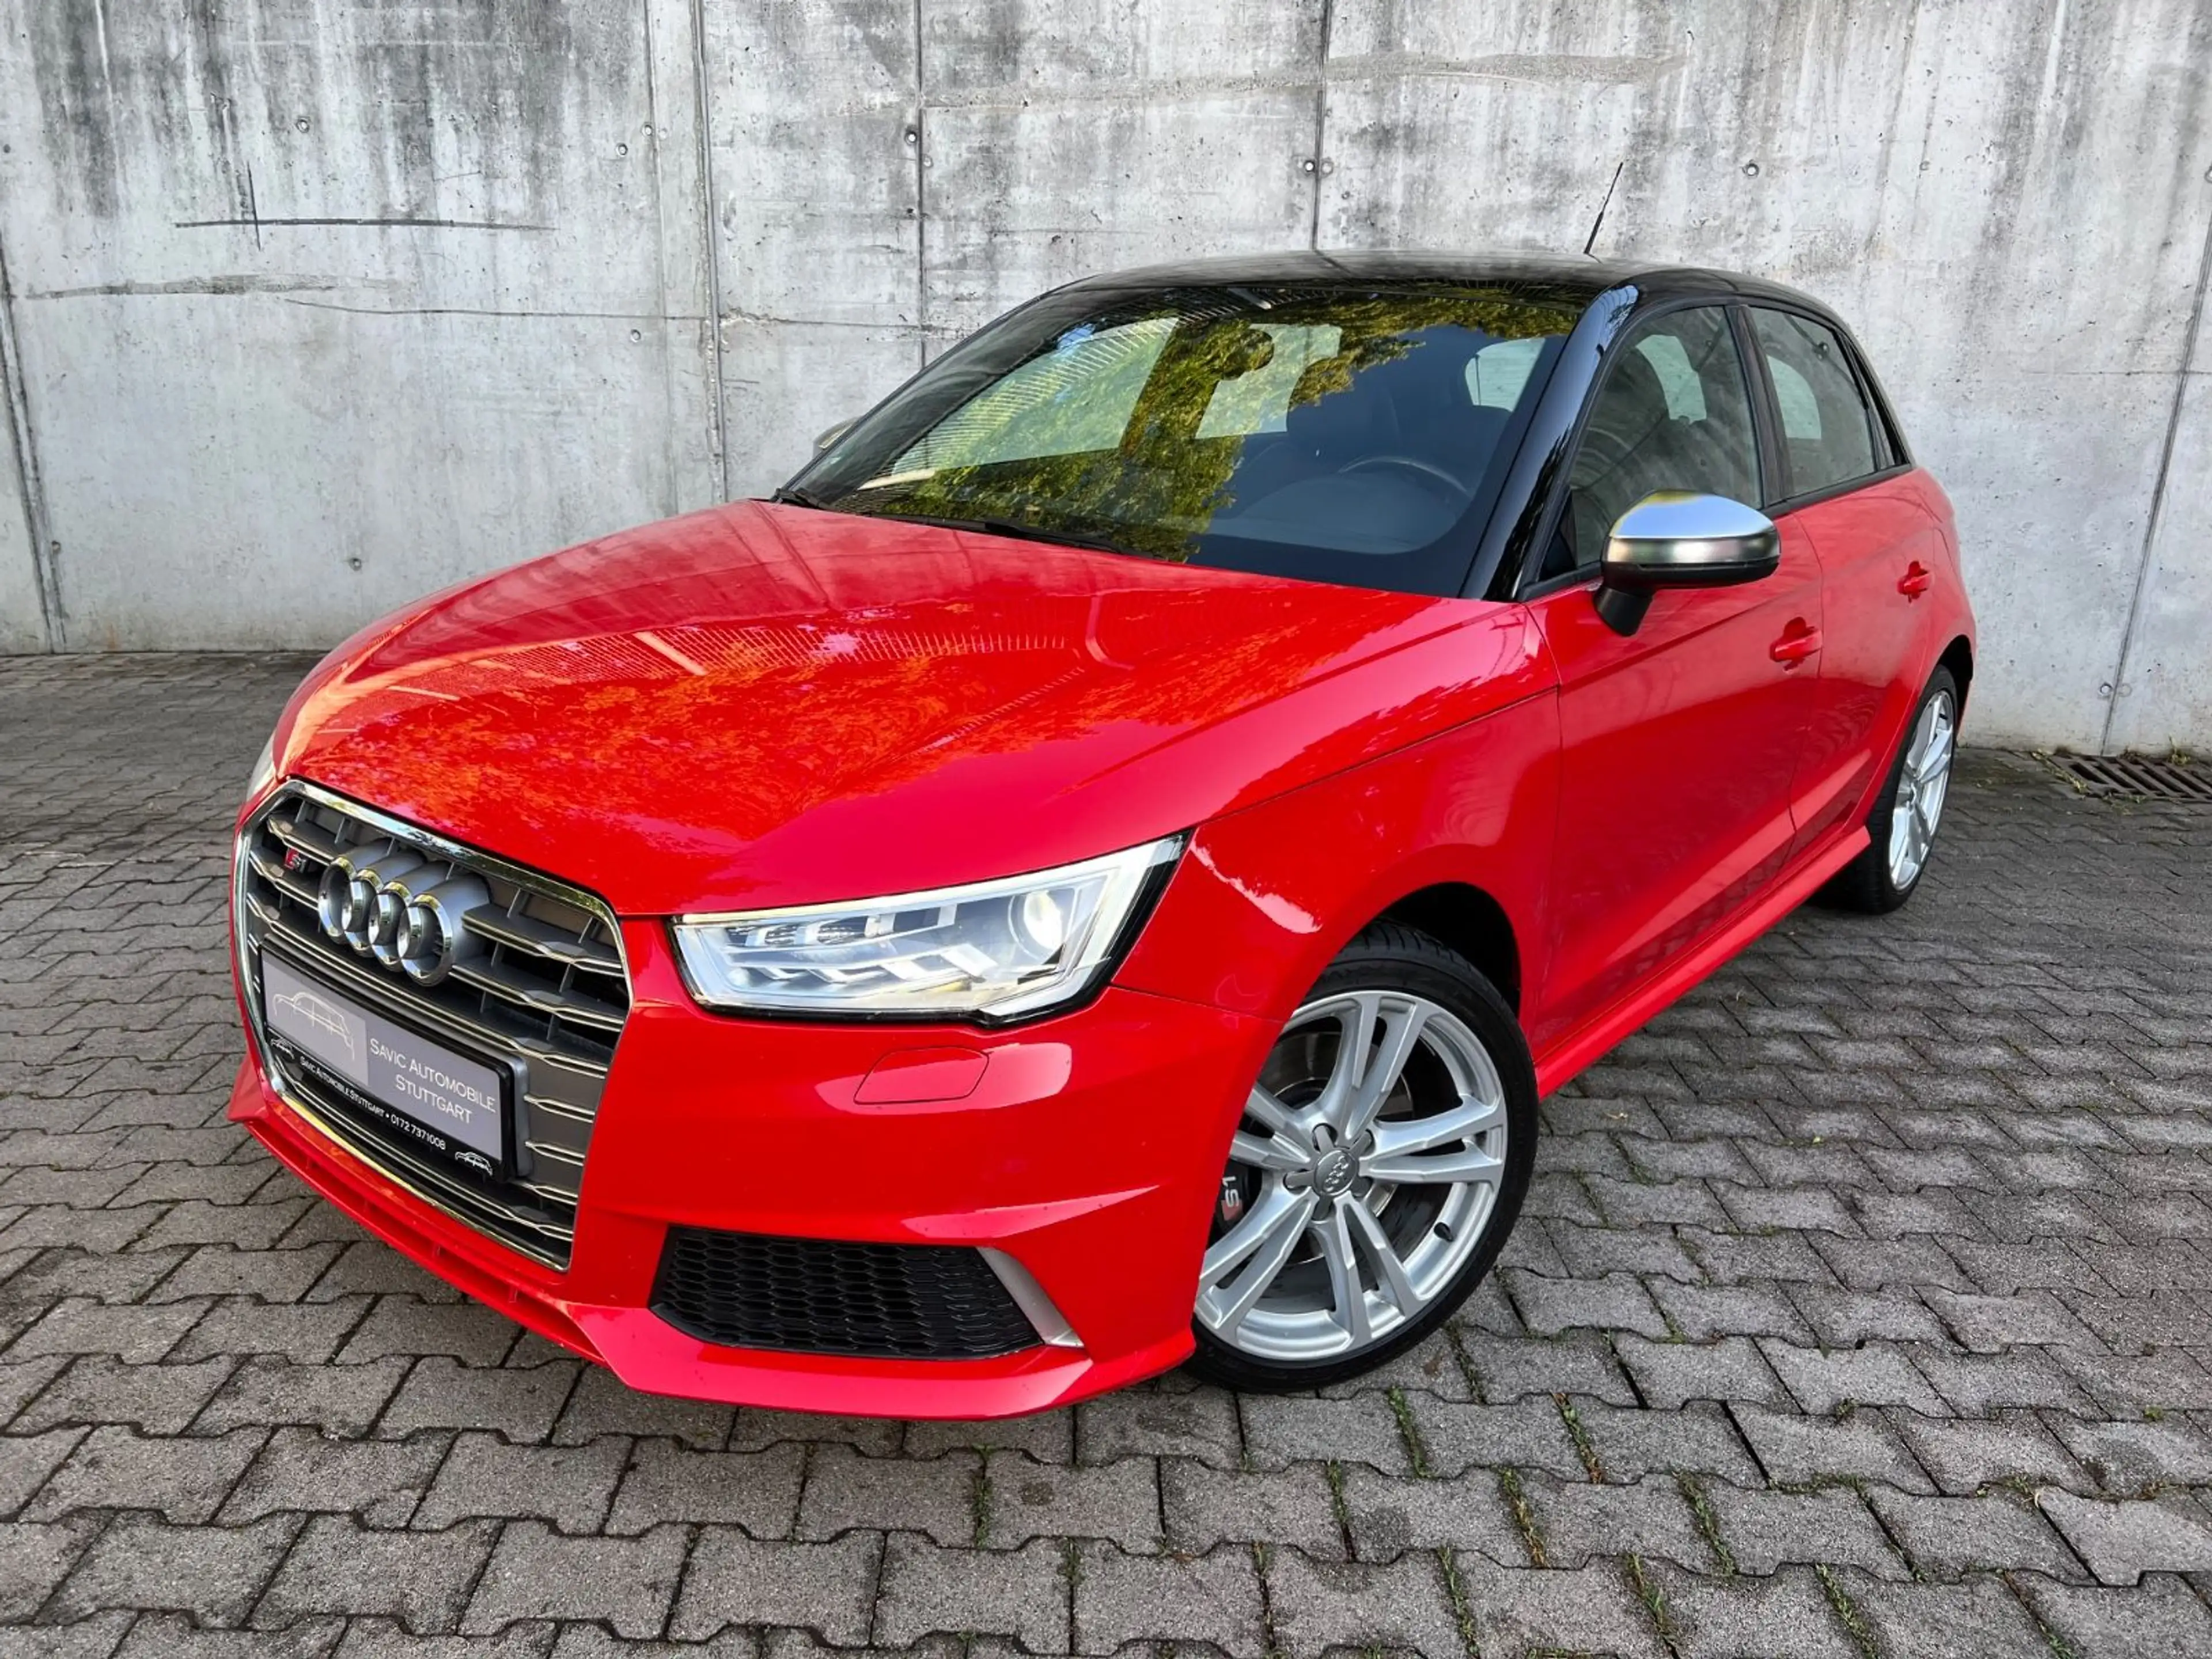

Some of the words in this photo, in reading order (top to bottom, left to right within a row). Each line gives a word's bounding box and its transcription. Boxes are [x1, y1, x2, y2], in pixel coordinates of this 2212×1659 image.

[370, 1037, 406, 1069] SAVIC
[408, 1058, 496, 1113] AUTOMOBILE
[395, 1073, 473, 1123] STUTTGART
[391, 1114, 410, 1132] 0172
[1222, 1176, 1239, 1207] S1
